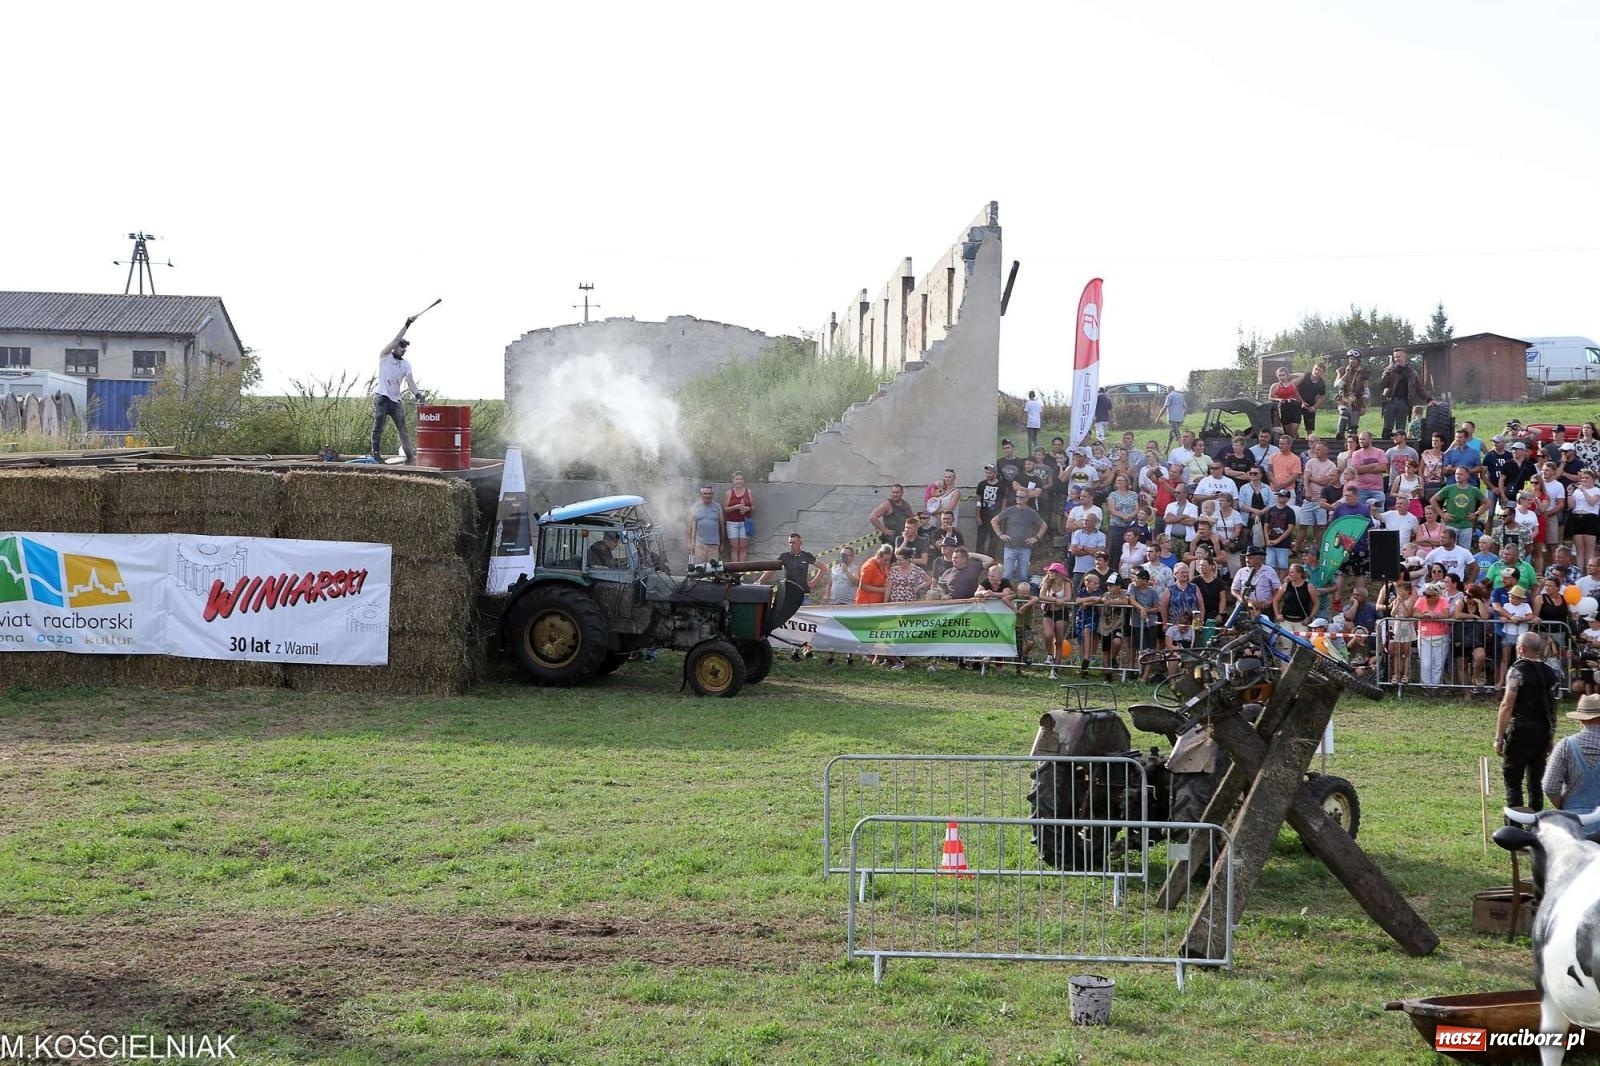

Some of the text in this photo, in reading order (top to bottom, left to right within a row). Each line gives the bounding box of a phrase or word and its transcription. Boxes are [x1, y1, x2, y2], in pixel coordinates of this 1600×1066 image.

[419, 413, 441, 422] Mobil
[203, 569, 368, 622] WINIARSKI
[43, 612, 133, 629] raciborski
[898, 617, 970, 628] WYPOSAŻENIE
[37, 634, 73, 644] oaza
[868, 628, 1001, 639] ELEKTRYCZNE POJAZDÓW
[229, 636, 319, 656] 30 lat z Wami!
